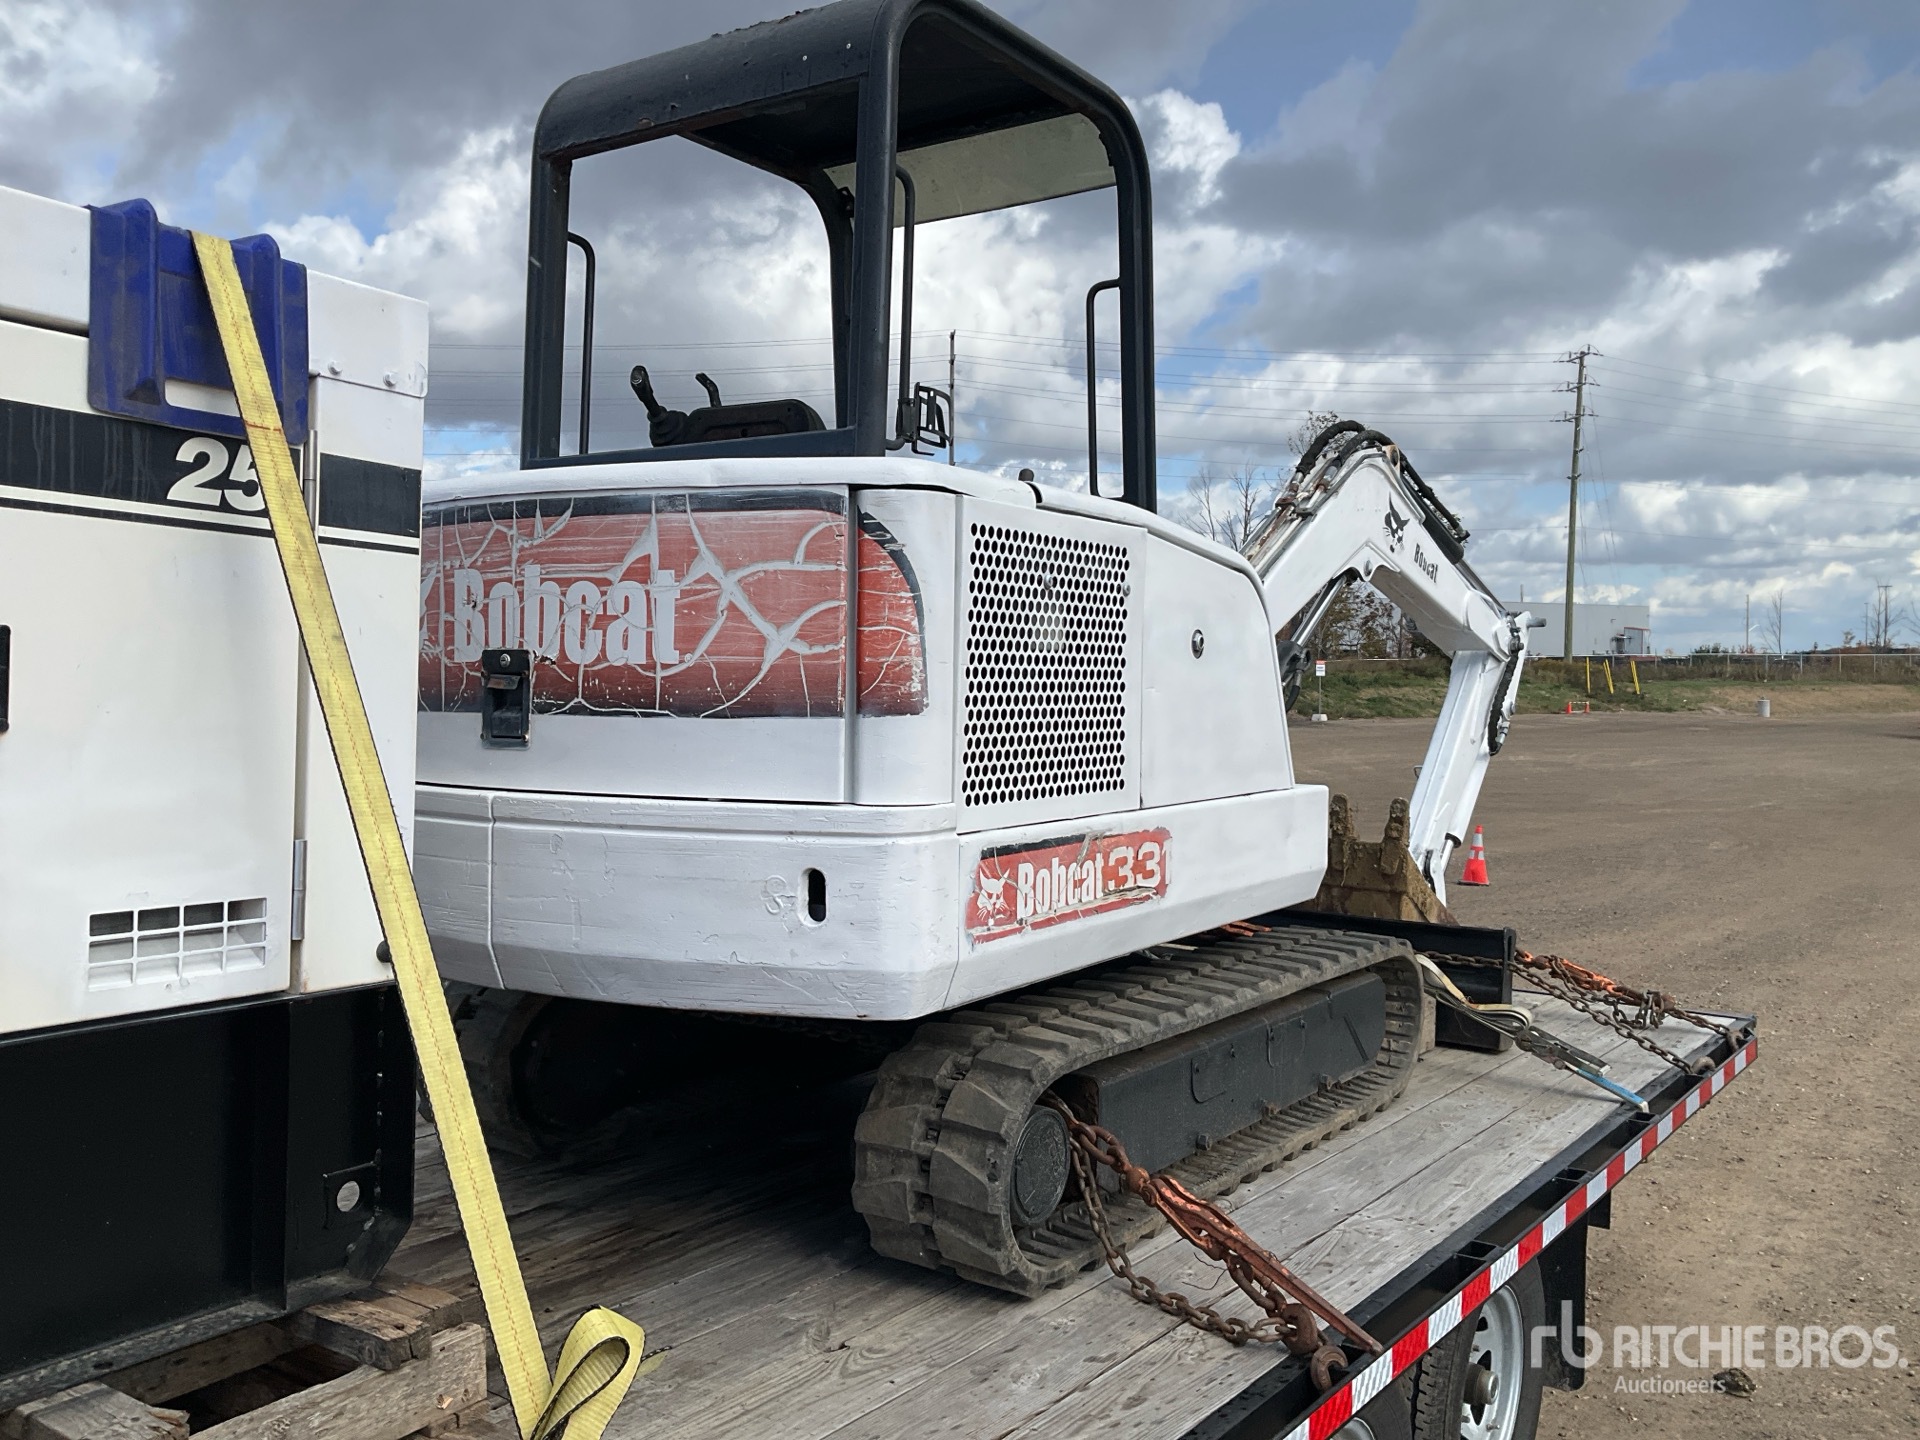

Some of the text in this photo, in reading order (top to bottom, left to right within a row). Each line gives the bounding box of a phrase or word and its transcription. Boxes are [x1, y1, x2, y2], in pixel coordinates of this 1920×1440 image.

[167, 437, 267, 512] 25
[453, 564, 681, 666] Bobcat
[1016, 852, 1104, 920] Bobcat
